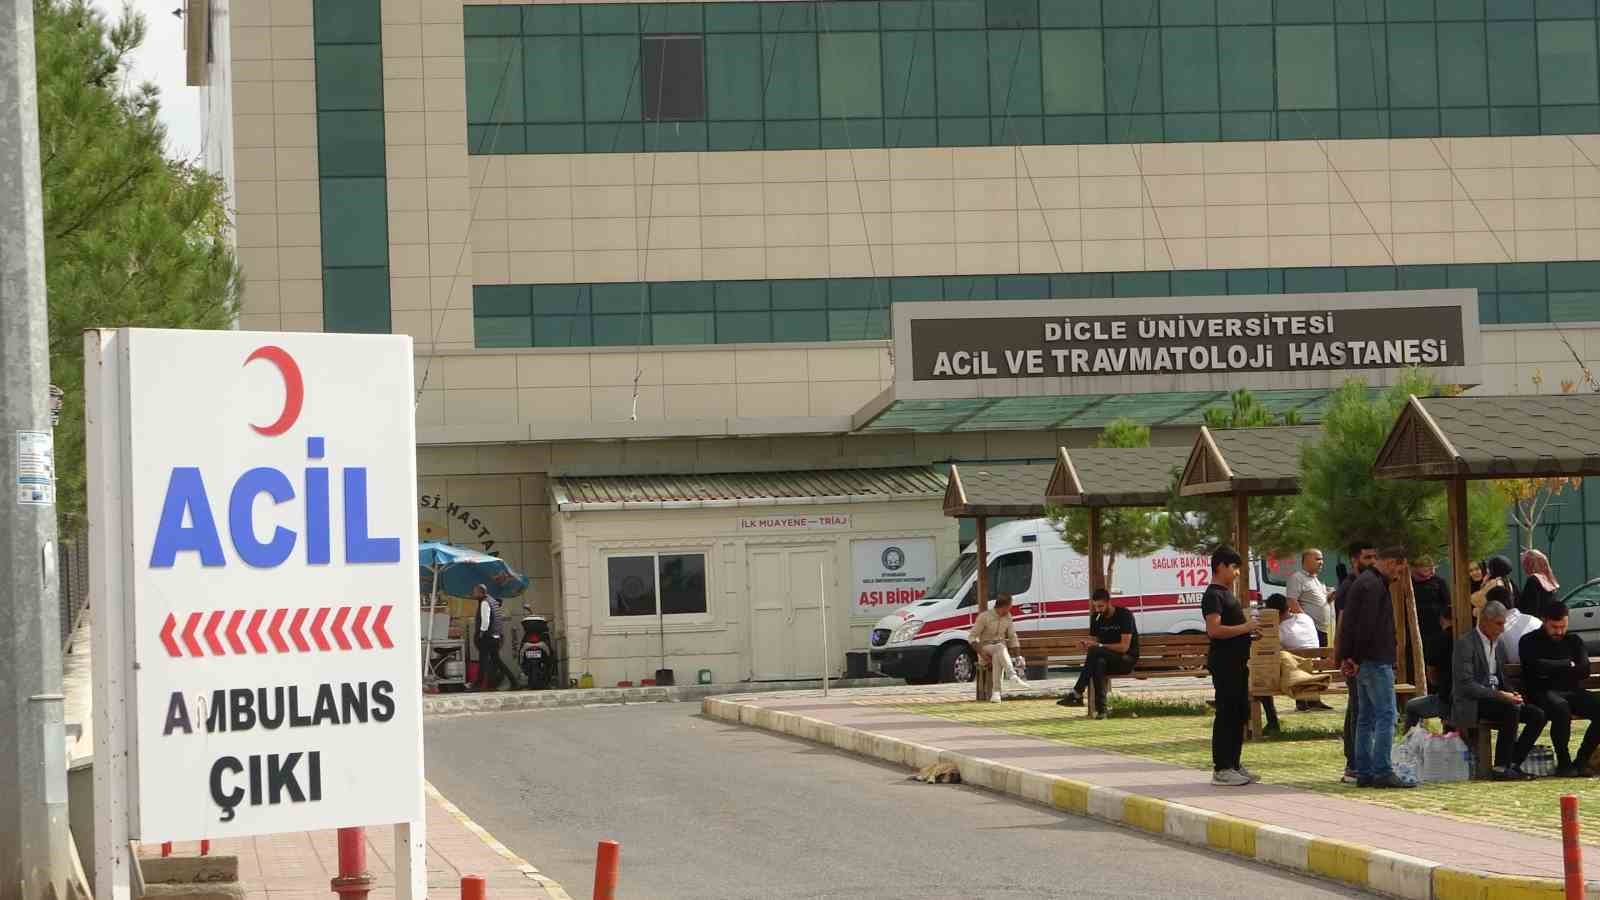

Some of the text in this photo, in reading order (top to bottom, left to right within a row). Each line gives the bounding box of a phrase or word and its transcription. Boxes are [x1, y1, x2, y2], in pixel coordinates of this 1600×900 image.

[1044, 312, 1334, 342] DİCLE ÜNİVERSİTESİ
[1005, 350, 1044, 374] VE
[149, 436, 401, 569] ACİL
[1176, 568, 1210, 587] 112
[859, 592, 883, 607] AŞI
[163, 680, 396, 736] AMBULANS
[209, 750, 322, 822] ÇIKI
